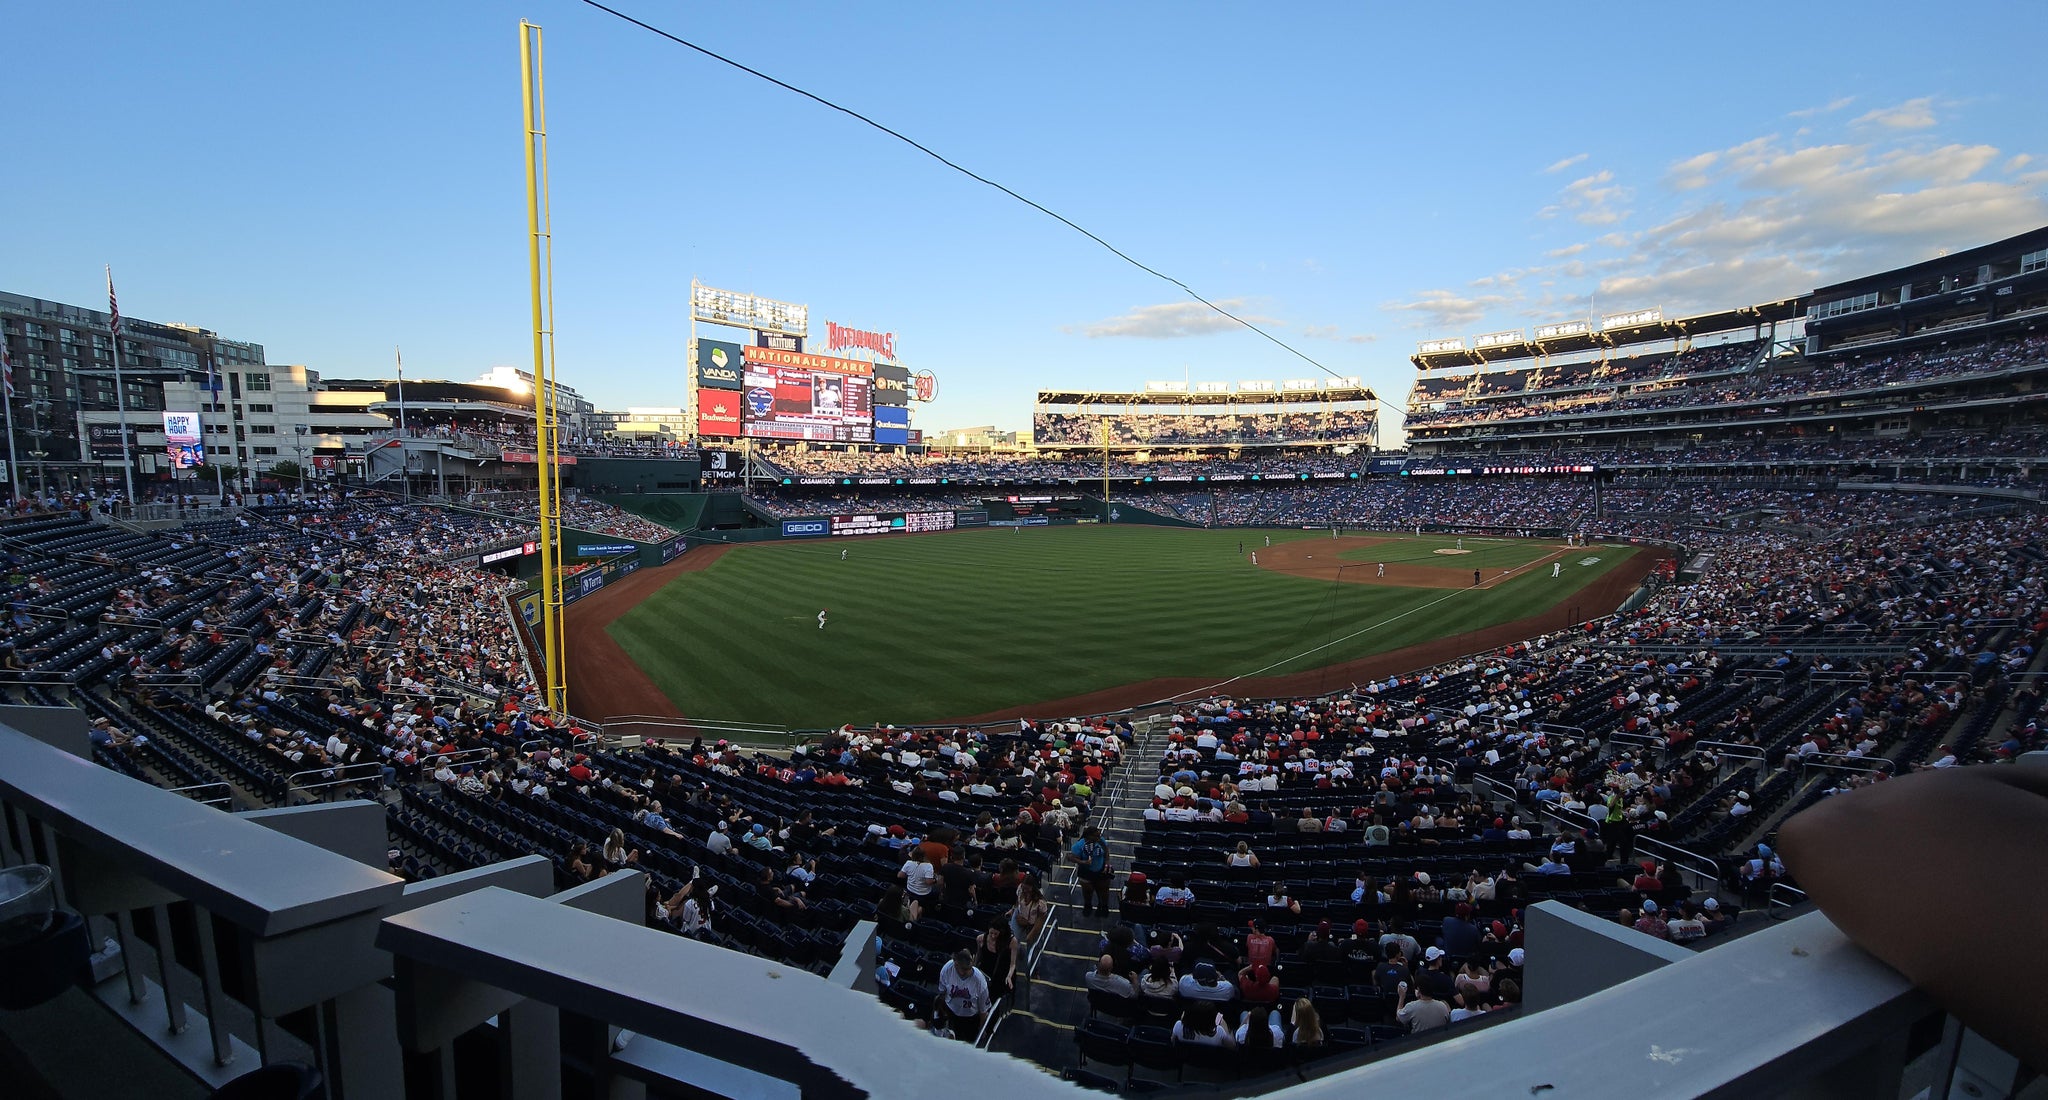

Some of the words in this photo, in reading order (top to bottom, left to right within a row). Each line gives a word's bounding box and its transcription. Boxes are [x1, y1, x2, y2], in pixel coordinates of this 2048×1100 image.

[768, 337, 796, 350] NATITUDE
[828, 321, 893, 359] NATIONALS
[749, 349, 827, 368] NATIONALS
[834, 361, 865, 373] PARK
[702, 367, 738, 379] VANDA
[887, 380, 907, 391] PNC
[167, 416, 190, 426] HAPPY
[701, 412, 737, 423] Budweiser
[169, 425, 188, 434] HOUR
[875, 420, 907, 430] Qualcomm
[702, 470, 736, 479] BETMGM
[1411, 468, 1445, 476] CASAMIGOS
[787, 523, 823, 533] GEICO
[589, 575, 602, 589] Terra
[962, 1000, 973, 1009] 20
